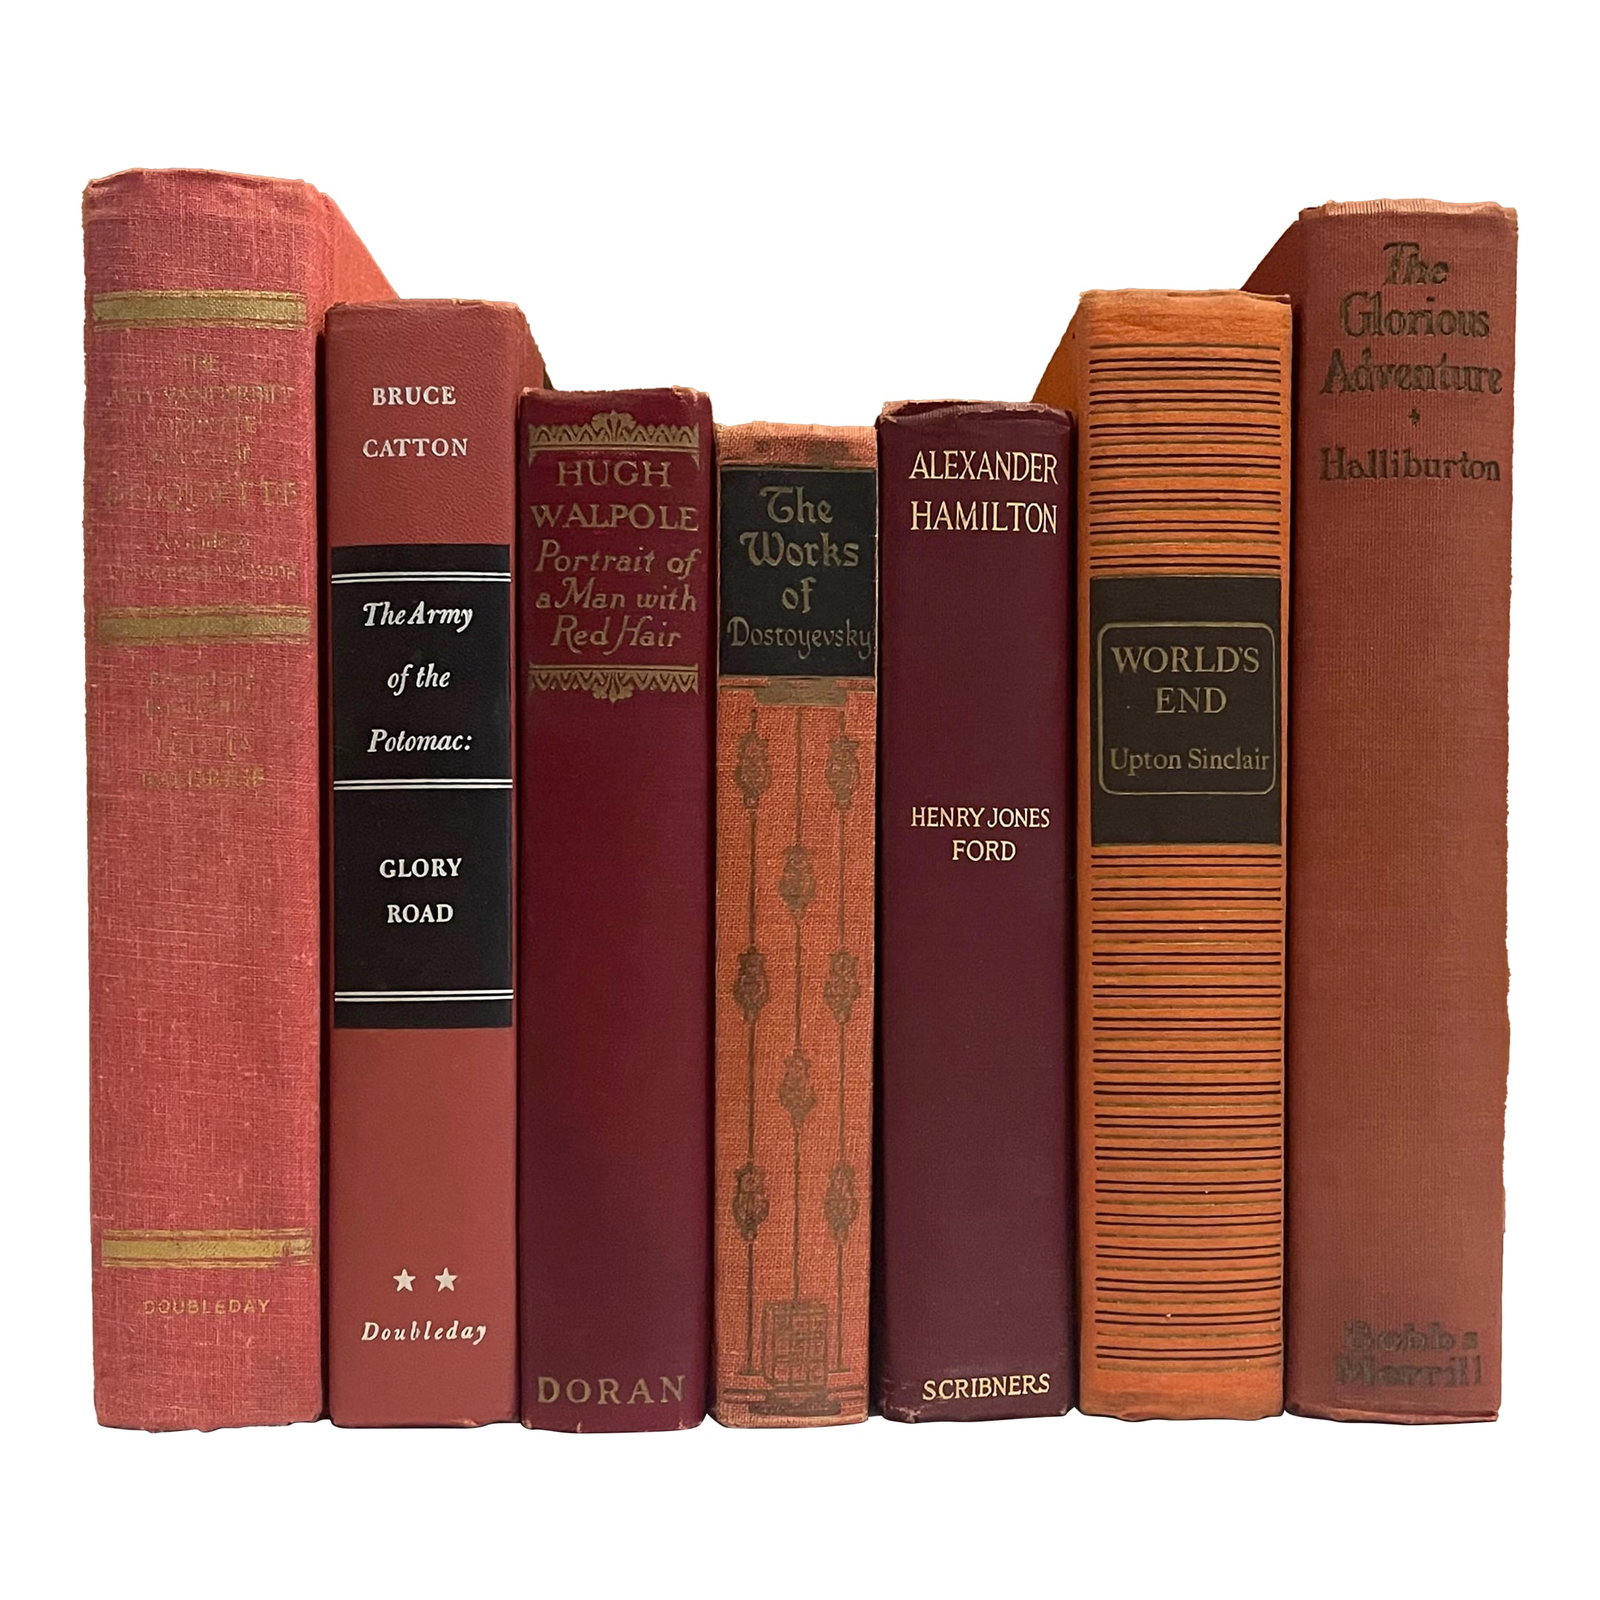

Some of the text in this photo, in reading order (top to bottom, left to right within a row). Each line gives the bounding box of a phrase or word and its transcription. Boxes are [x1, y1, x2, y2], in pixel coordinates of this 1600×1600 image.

[1383, 241, 1450, 286] The
[1340, 291, 1490, 338] Glorious
[1320, 347, 1503, 395] Adventure
[372, 385, 456, 406] BRUCE
[362, 437, 468, 457] CATTON
[556, 460, 672, 487] HUGH
[908, 450, 1059, 485] ALEXANDER
[1319, 446, 1501, 482] Halliburton
[530, 503, 699, 531] WALPOLE
[759, 485, 834, 524] The
[910, 500, 1058, 534] HAMILTON
[535, 539, 702, 580] Portrait of
[739, 531, 860, 567] Works
[535, 577, 698, 612] a Man with
[782, 576, 817, 614] of
[362, 601, 473, 633] The Army
[551, 614, 681, 656] Red Hair
[726, 616, 872, 660] Dostoyevsky
[1111, 646, 1260, 674] WORLD'S
[387, 663, 451, 696] of the
[1154, 687, 1228, 714] END
[367, 729, 472, 753] Potomac:
[1110, 746, 1270, 777] Upton Sinclair
[911, 806, 1051, 828] HENRY JONES
[952, 839, 1017, 862] FORD
[379, 857, 462, 878] GLORY
[387, 904, 454, 923] ROAD
[143, 1299, 270, 1315] DOUBLEDAY
[361, 1320, 487, 1346] Doubleday
[537, 1375, 686, 1405] DORAN
[922, 1373, 1051, 1401] SCRIBNERS
